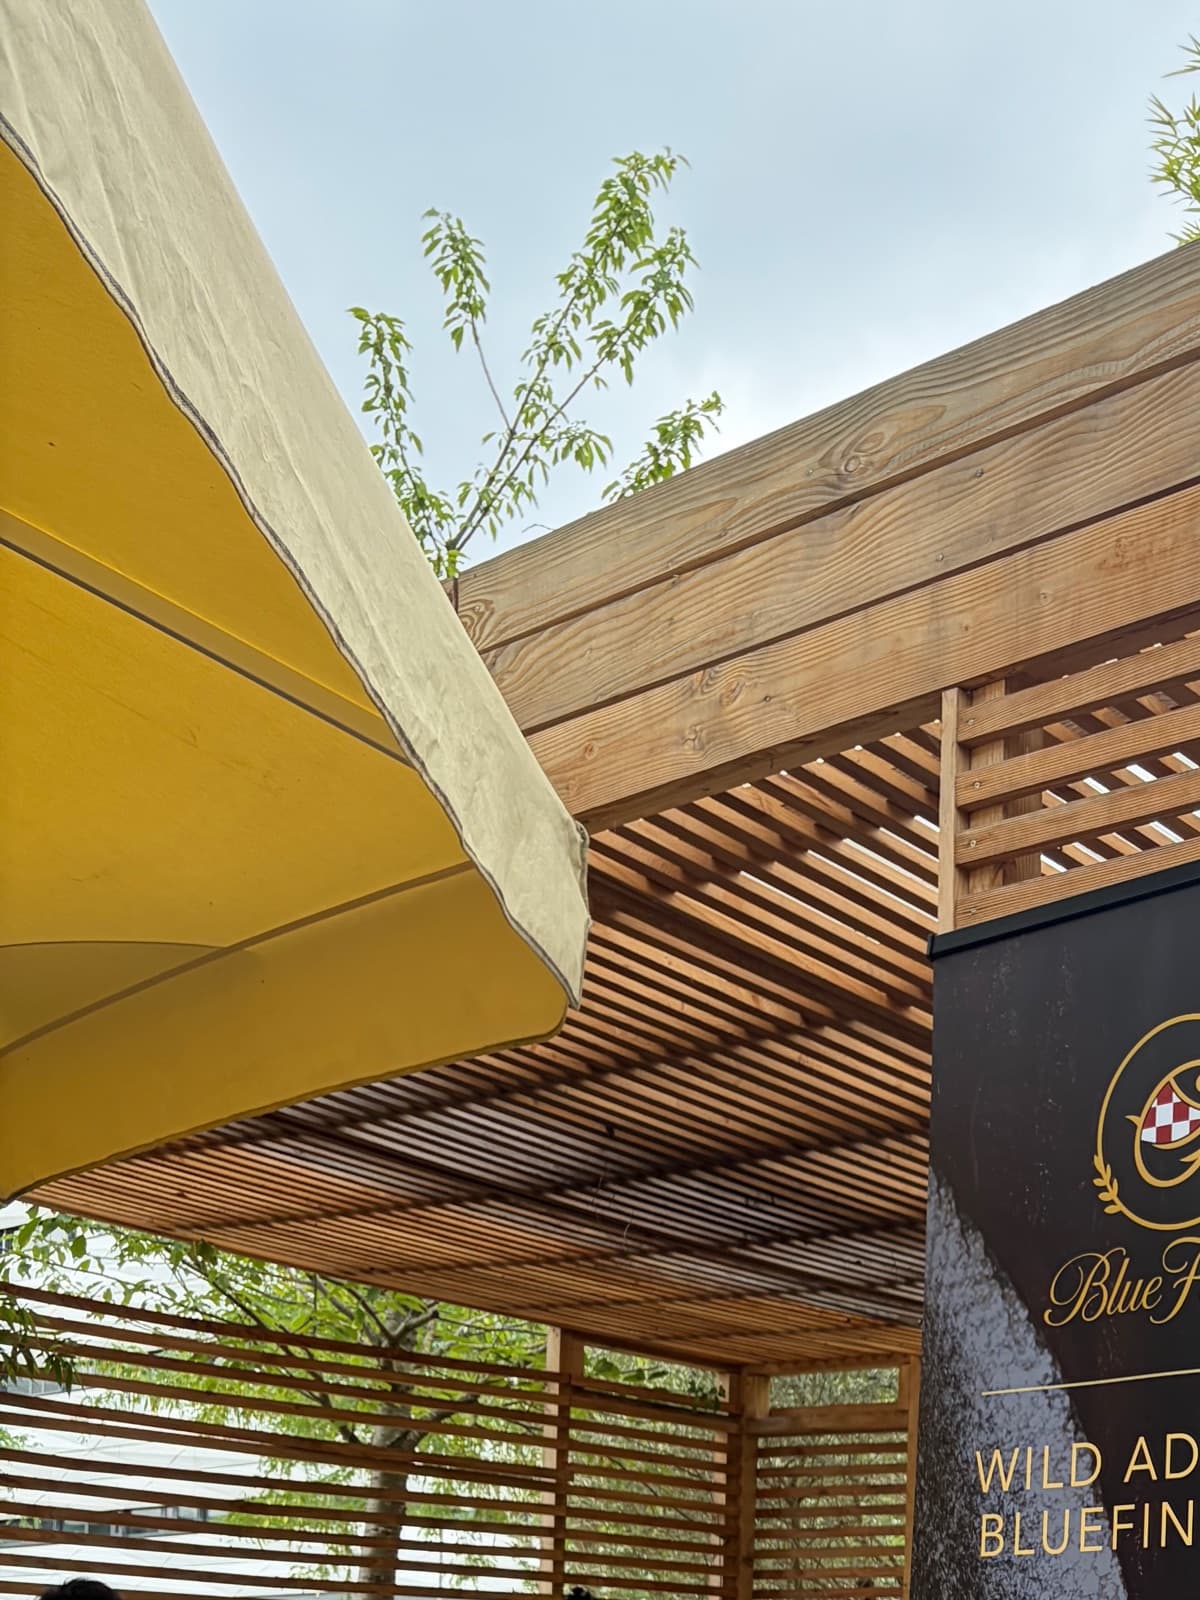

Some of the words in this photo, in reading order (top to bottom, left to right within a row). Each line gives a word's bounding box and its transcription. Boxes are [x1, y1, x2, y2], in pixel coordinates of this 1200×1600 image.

[1043, 1246, 1162, 1327] Blue
[975, 1442, 1102, 1493] WILD
[979, 1500, 1194, 1558] BLUEFIN
